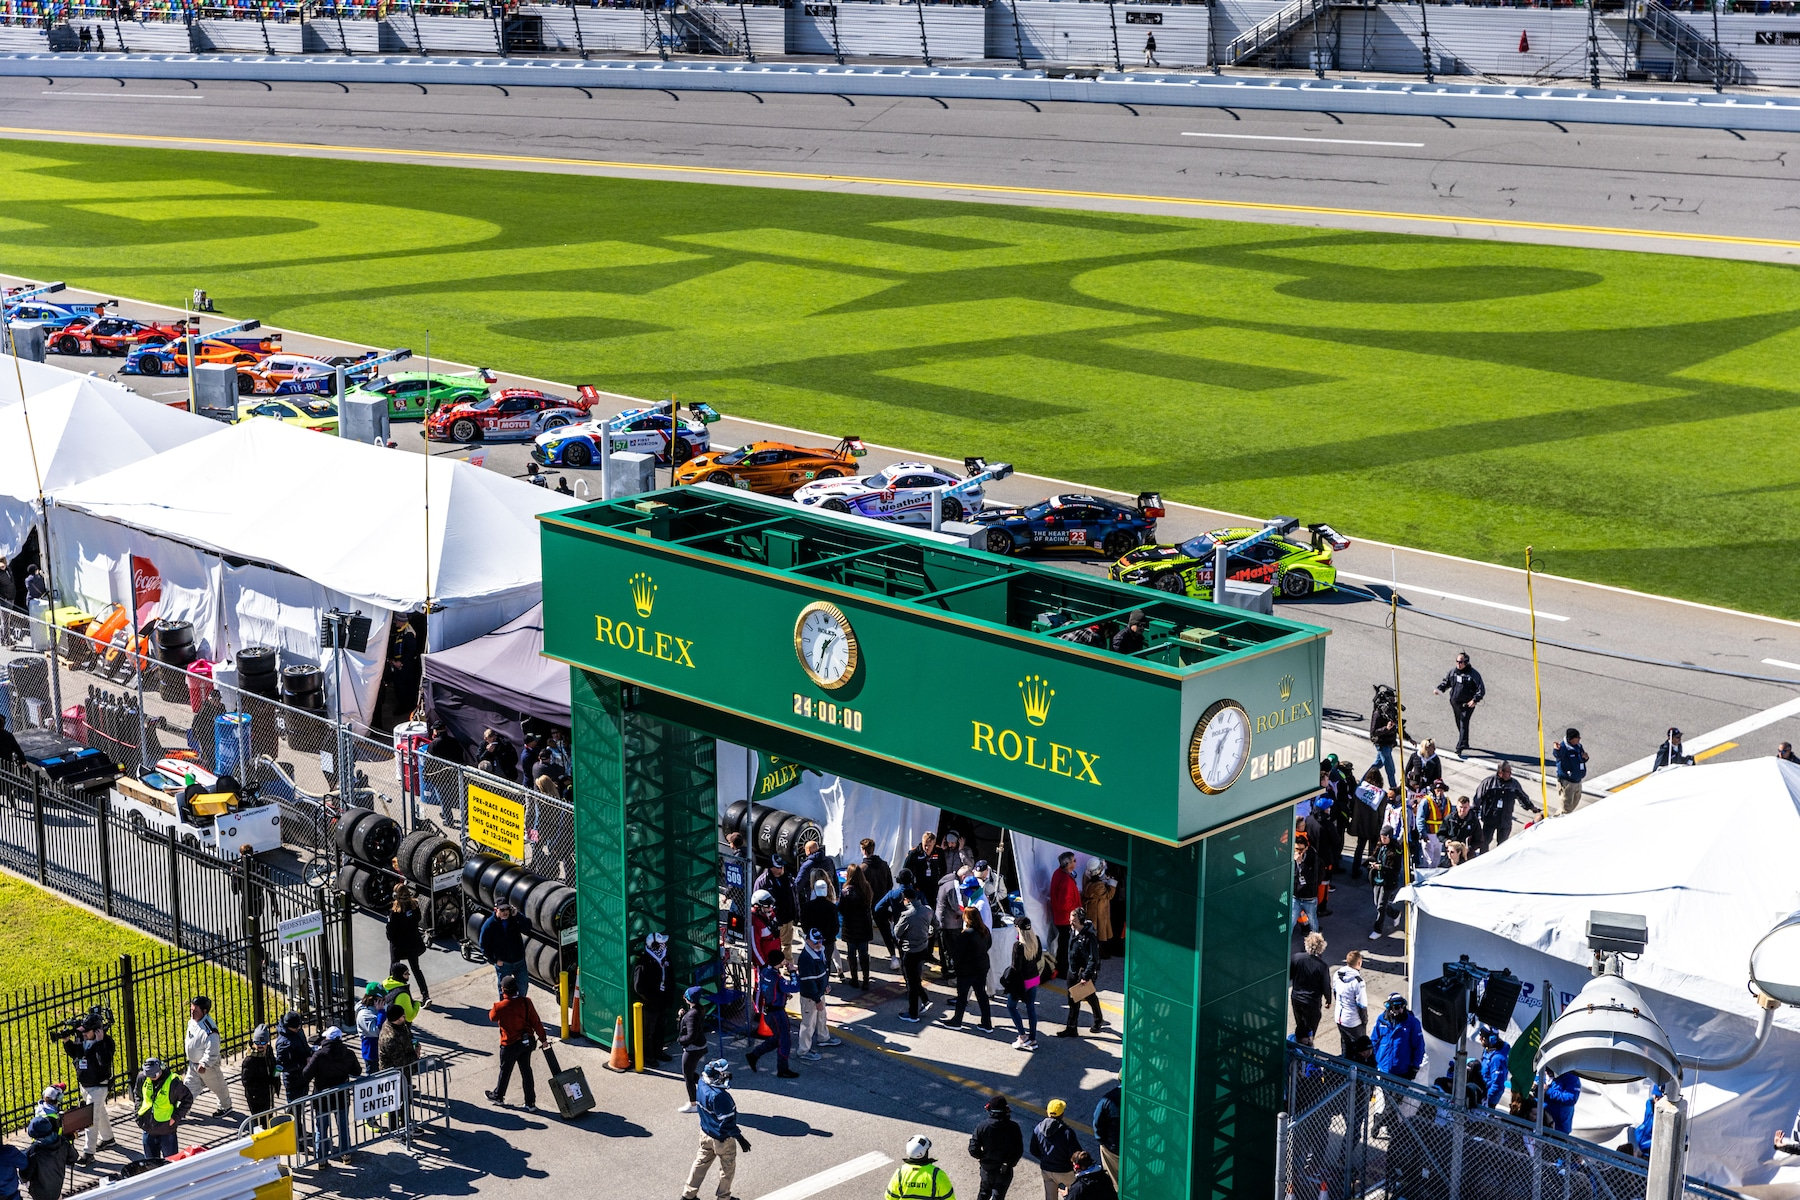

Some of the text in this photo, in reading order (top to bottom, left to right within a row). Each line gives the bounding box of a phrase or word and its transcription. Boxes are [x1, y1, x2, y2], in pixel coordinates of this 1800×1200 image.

[165, 362, 173, 371] 74
[395, 400, 405, 408] 63
[488, 420, 529, 429] 9 MOTUL
[615, 441, 627, 450] 57
[879, 491, 932, 512] WeatherT
[882, 492, 893, 500] 15
[1071, 532, 1085, 541] 23
[1199, 571, 1211, 580] 14
[818, 627, 835, 636] ROLEX
[595, 615, 696, 668] ROLEX
[793, 693, 862, 732] 24:00:00
[1255, 699, 1313, 734] ROLEX
[1211, 727, 1232, 738] ROLEX
[971, 720, 1102, 786] ROLEX
[1251, 736, 1316, 781] 24:00:00
[761, 764, 799, 794] ROLEX
[472, 796, 519, 820] PRE-RACE ACCESS
[472, 806, 490, 818] OPENS
[500, 817, 520, 830] 12:05PM
[472, 816, 519, 840] THIS GATE CLOSES
[726, 871, 742, 885] 509
[280, 914, 321, 932] PEDESTRIANS
[360, 1080, 397, 1099] DO NOT
[363, 1095, 394, 1113] ENTER
